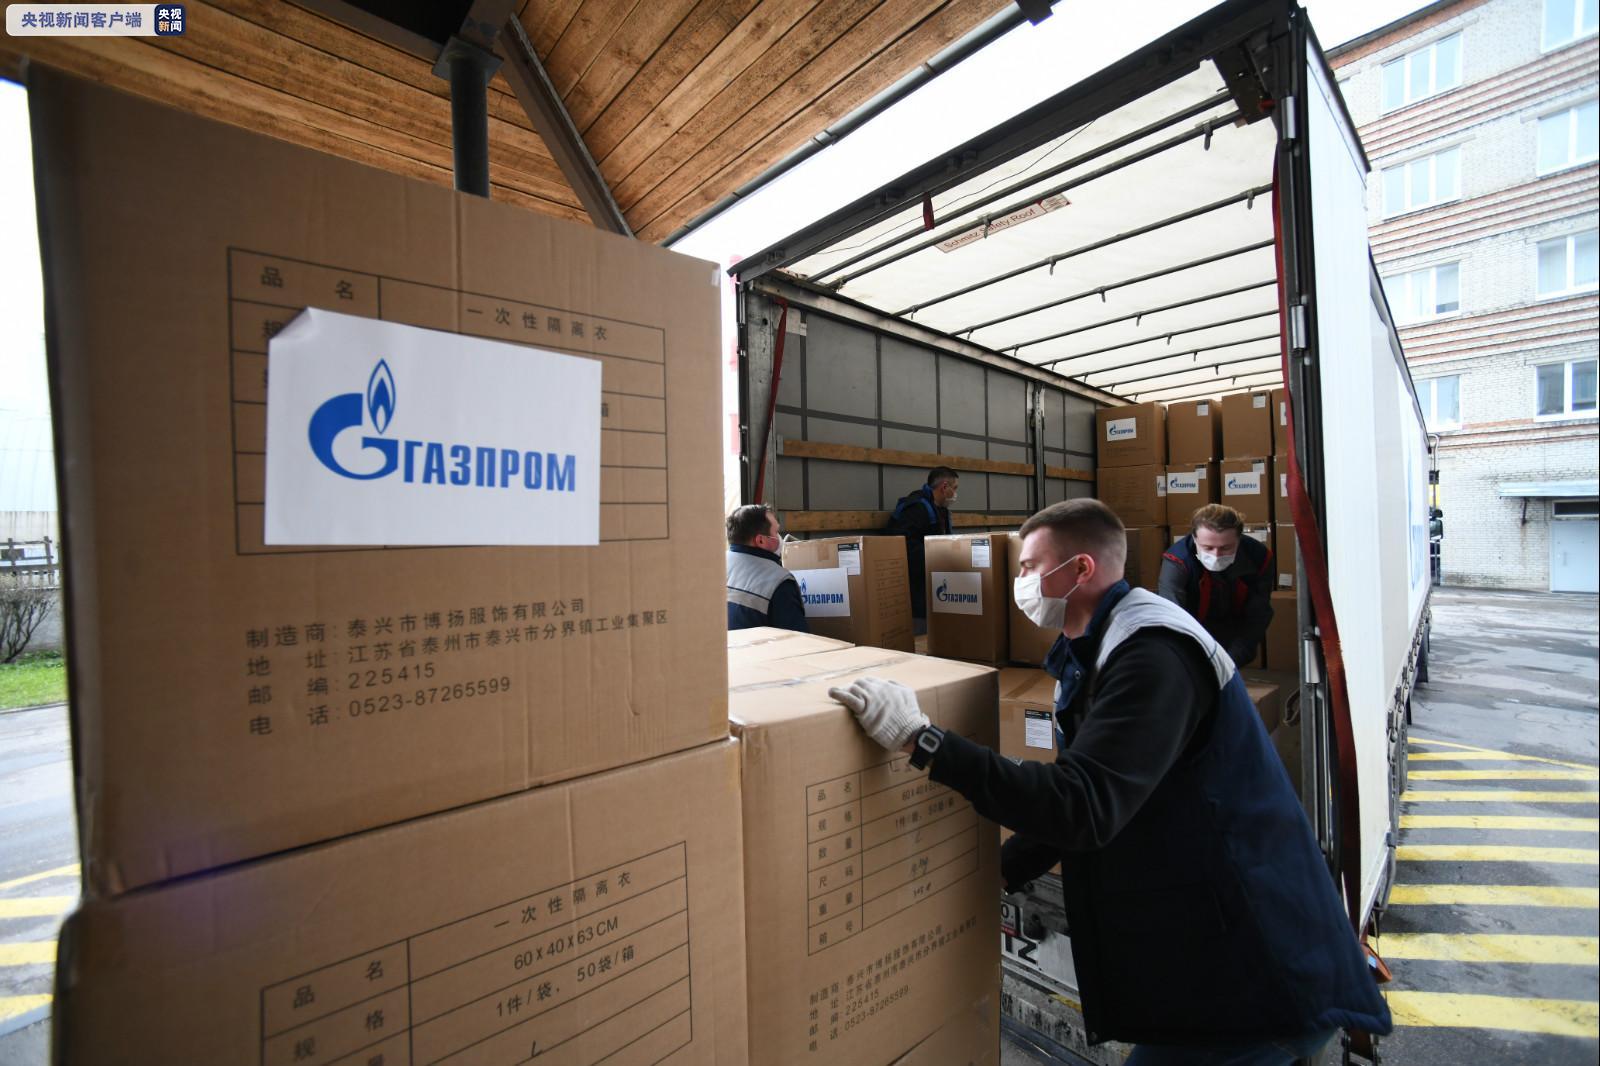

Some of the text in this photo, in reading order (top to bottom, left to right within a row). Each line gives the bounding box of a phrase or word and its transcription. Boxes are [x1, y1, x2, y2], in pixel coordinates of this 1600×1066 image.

[944, 230, 979, 248] Schmitz
[1011, 208, 1036, 222] Roof
[467, 307, 608, 341] 一次性隔离衣
[403, 440, 576, 492] ГАЗПРОМ
[494, 872, 631, 928] 一次性隔离衣
